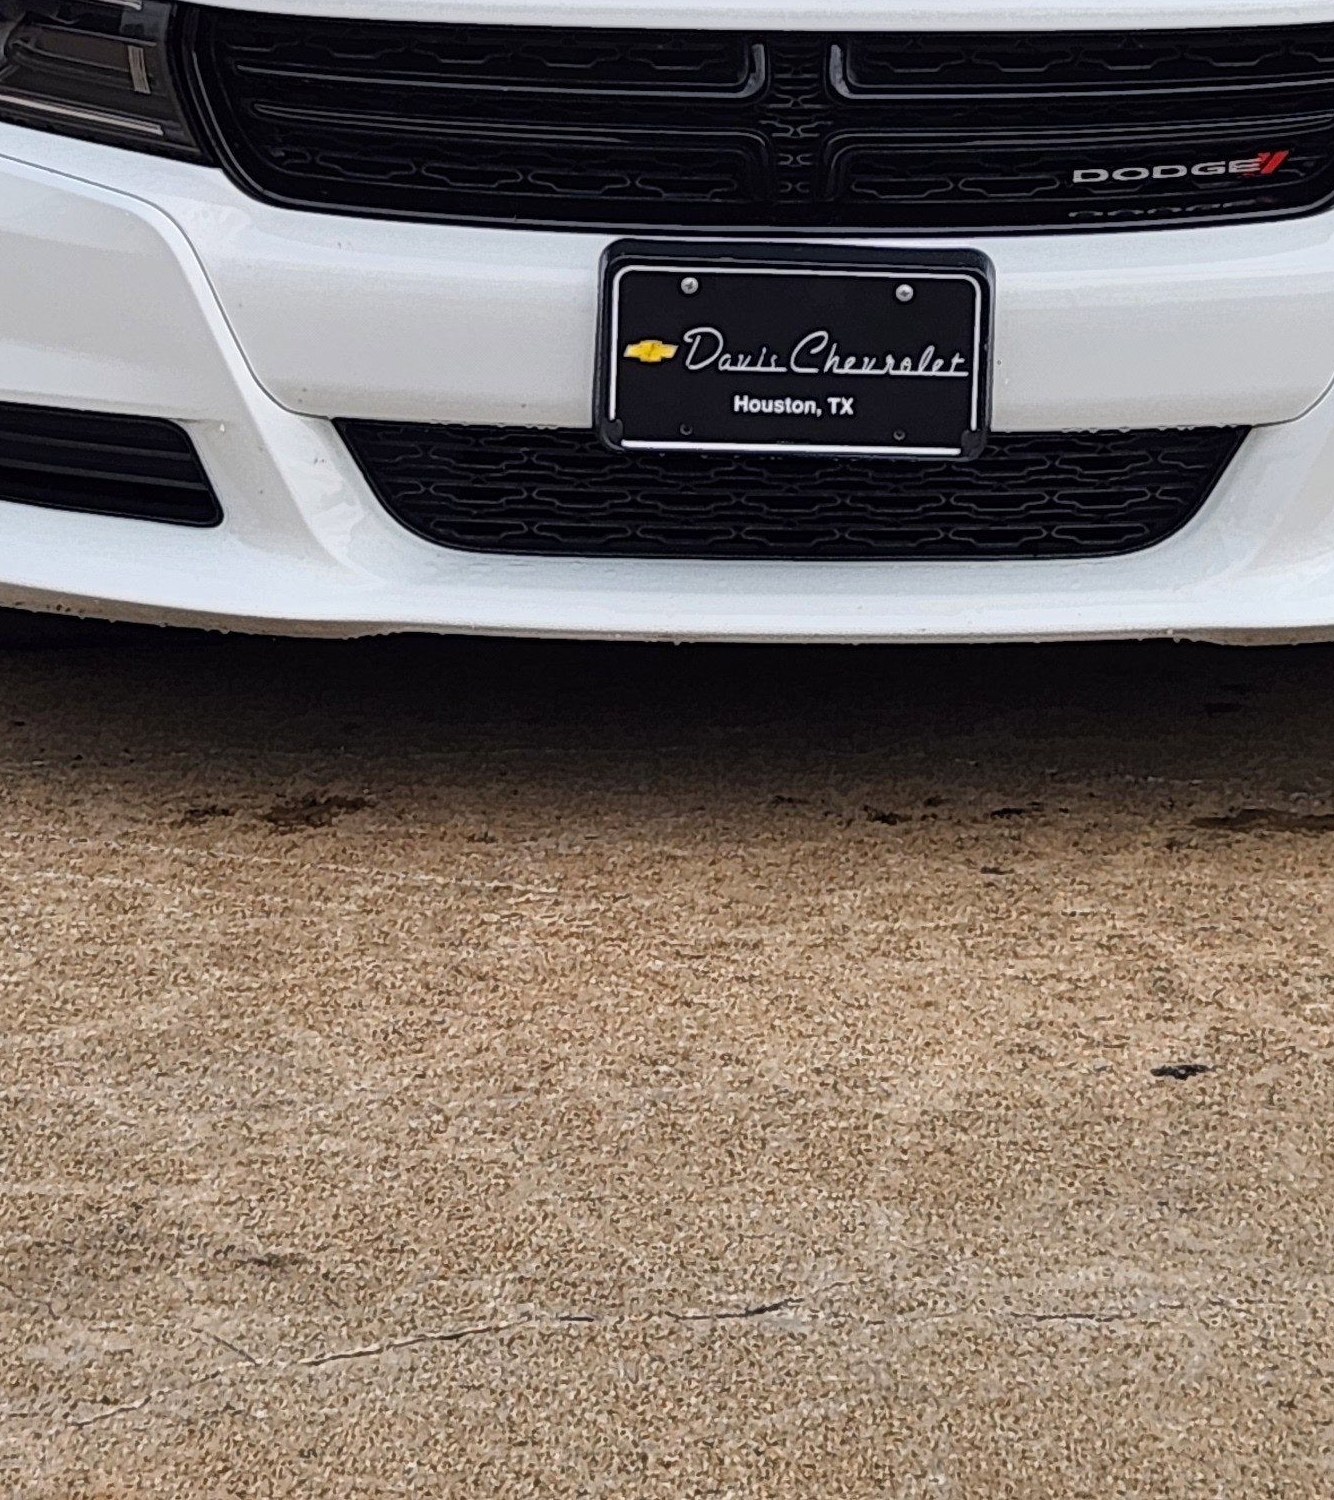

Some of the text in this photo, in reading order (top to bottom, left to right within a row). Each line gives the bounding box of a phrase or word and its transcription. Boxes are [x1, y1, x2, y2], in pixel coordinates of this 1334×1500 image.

[1073, 157, 1264, 184] DODGE
[683, 326, 969, 377] Davis Chevrolet
[733, 395, 854, 417] Houston, TX
